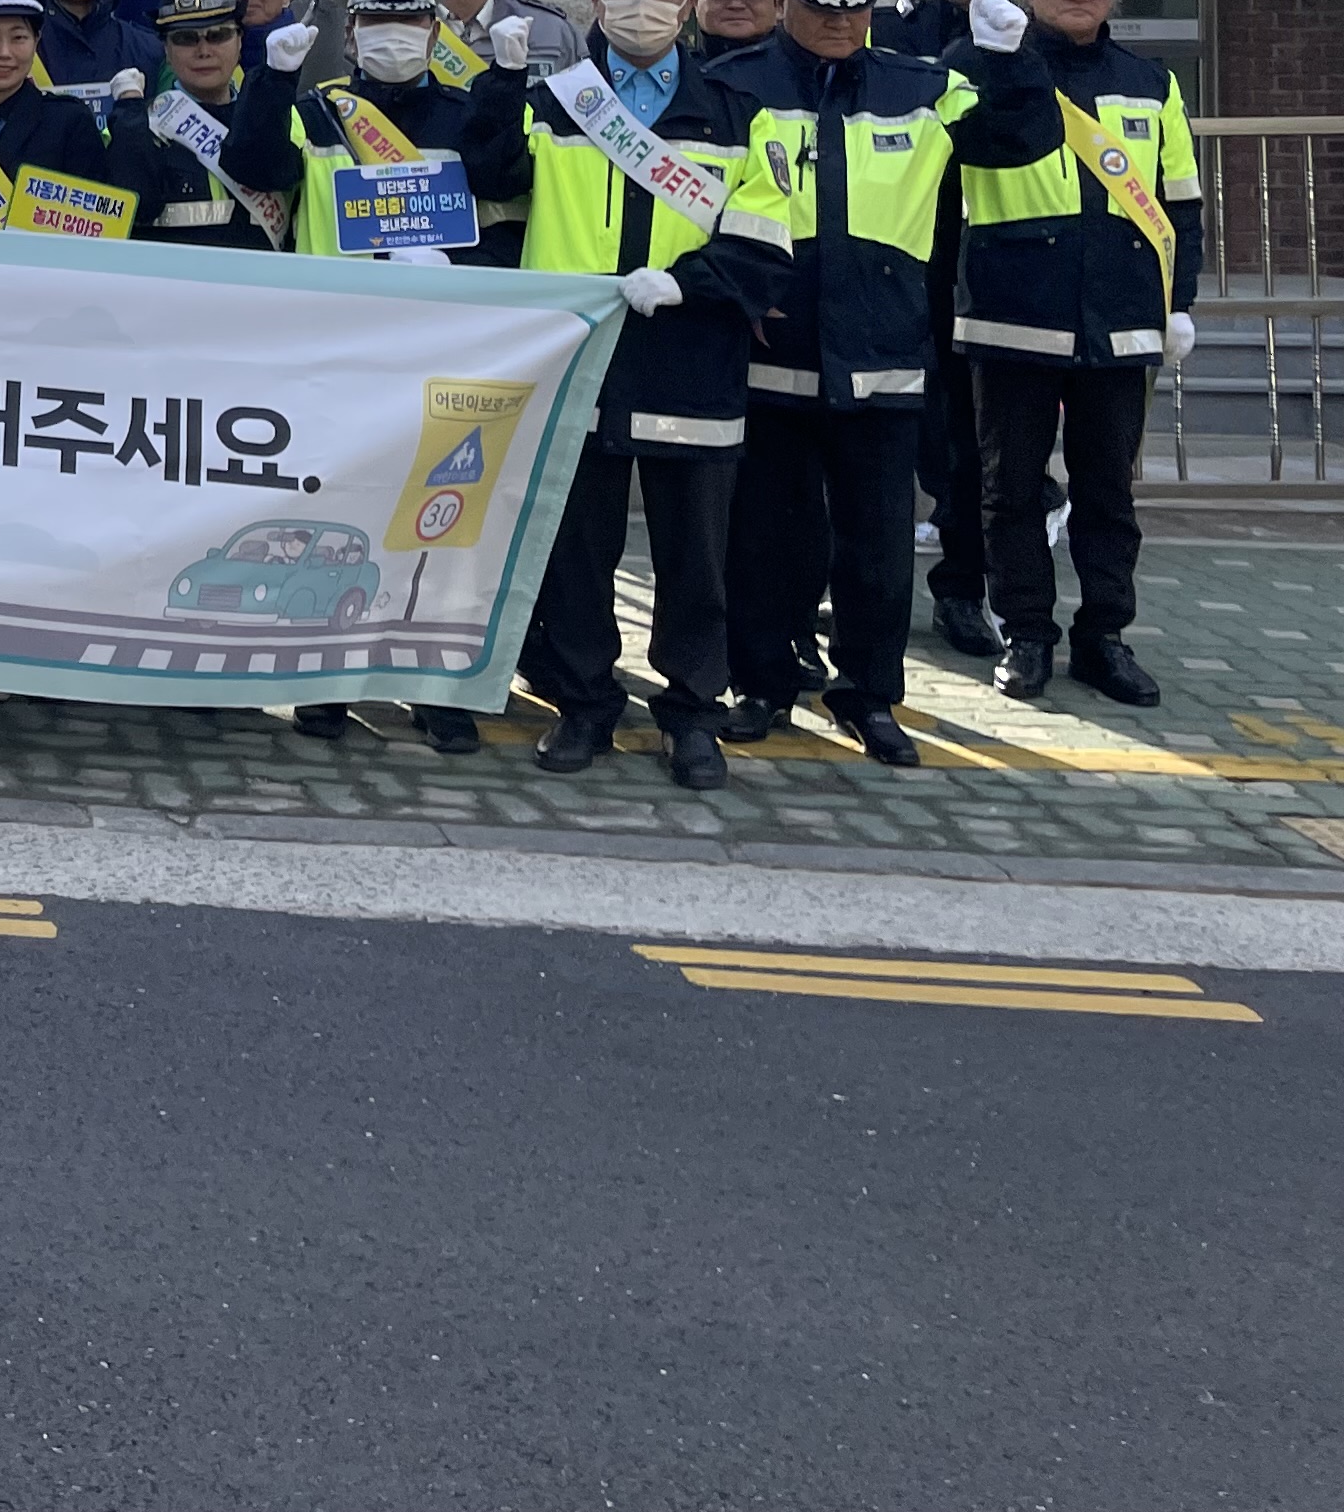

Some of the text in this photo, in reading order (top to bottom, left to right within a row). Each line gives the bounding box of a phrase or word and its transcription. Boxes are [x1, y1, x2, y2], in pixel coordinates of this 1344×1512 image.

[600, 115, 714, 209] 멈추고 살피고!
[25, 176, 125, 219] 자동차 주변에서
[376, 179, 417, 195] 횡단보도
[344, 192, 467, 219] 일단 멈춤! 아이 먼저
[379, 216, 434, 232] 보내주세요.
[424, 503, 458, 528] 30
